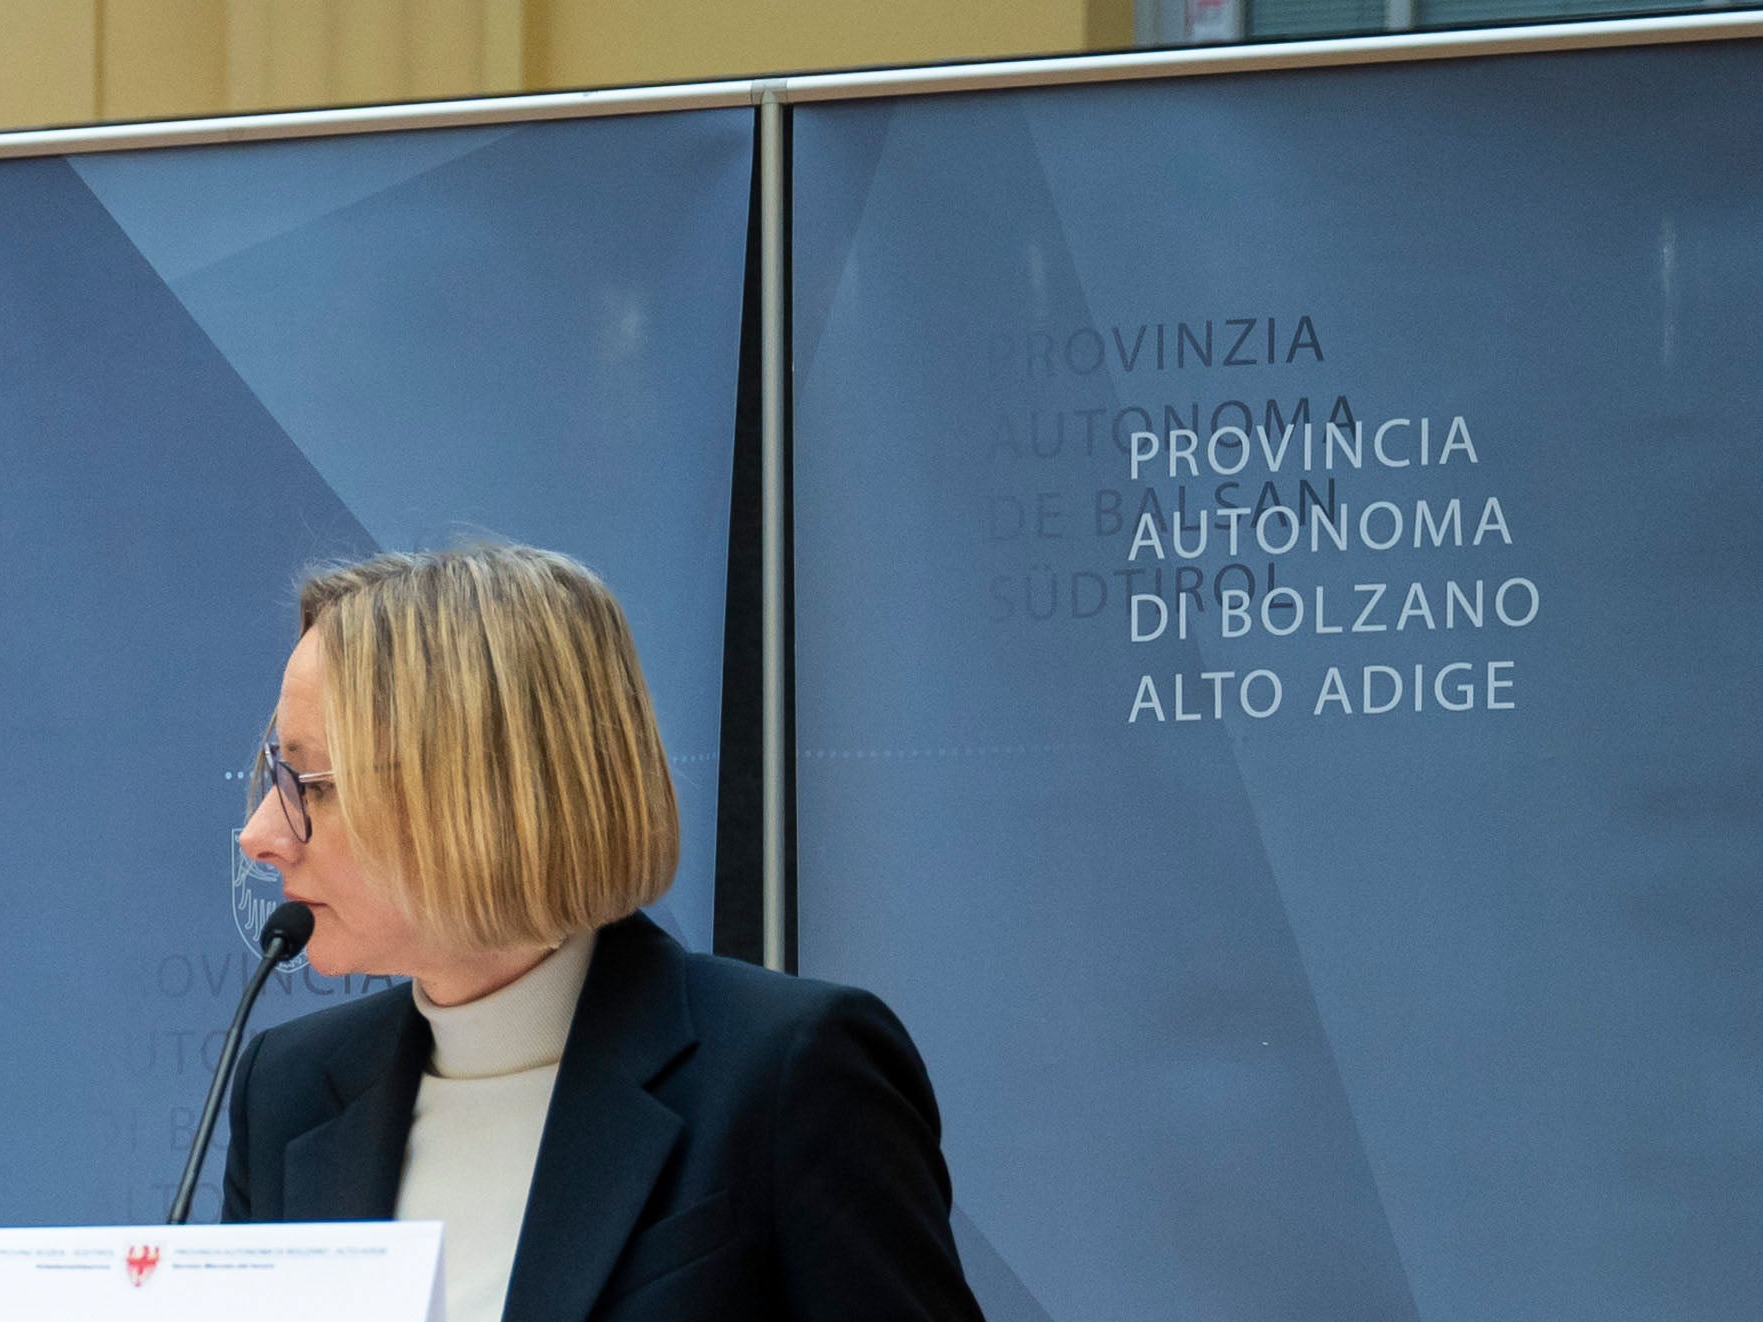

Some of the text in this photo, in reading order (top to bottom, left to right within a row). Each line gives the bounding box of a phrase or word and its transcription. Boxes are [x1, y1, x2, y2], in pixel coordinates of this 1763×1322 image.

[1129, 416, 1479, 479] PROVINCIA
[1128, 497, 1513, 561] AUTONOMA
[1130, 577, 1541, 642] DI BOLZANO
[1128, 661, 1516, 723] ALTO ADIGE
